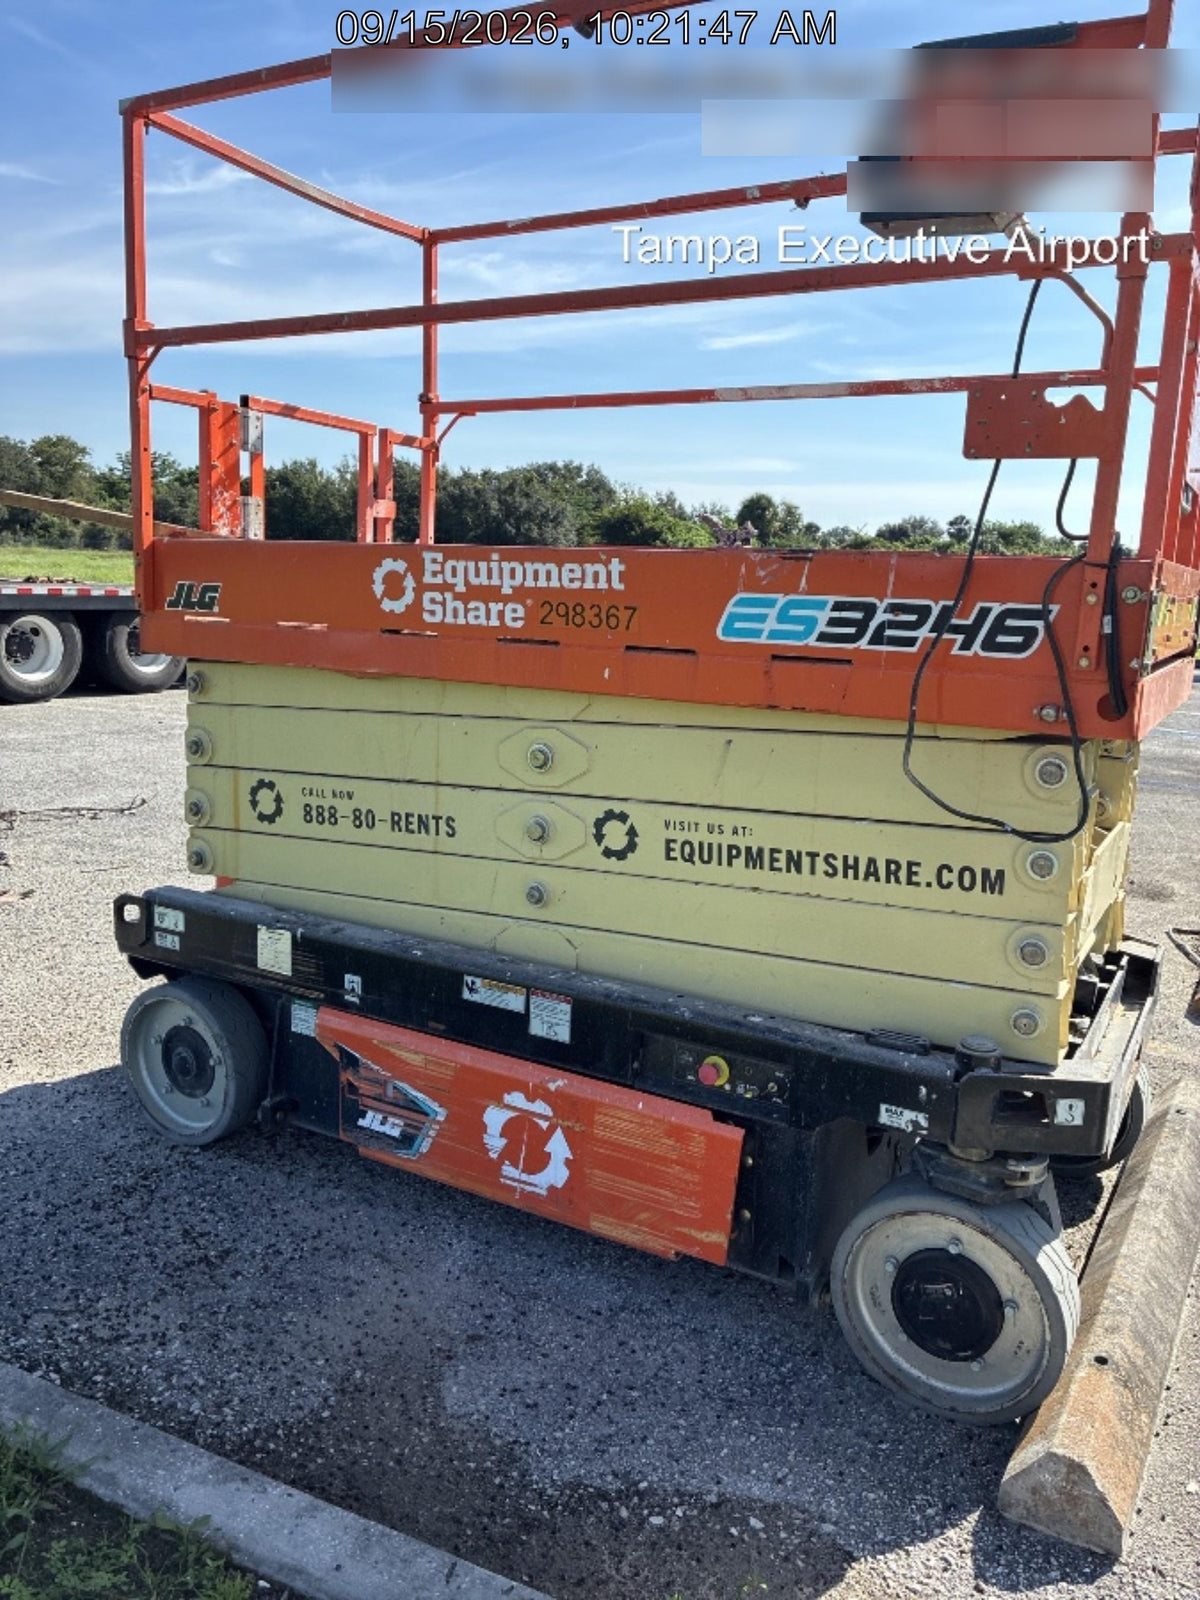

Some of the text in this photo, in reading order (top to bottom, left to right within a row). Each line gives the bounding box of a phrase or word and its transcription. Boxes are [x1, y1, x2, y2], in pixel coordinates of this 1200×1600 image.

[422, 551, 626, 594] Equipment
[164, 580, 222, 612] JLG
[422, 591, 638, 631] Share 298367
[717, 593, 1059, 658] ES3246
[301, 787, 355, 800] CALL NOW
[303, 803, 456, 838] 888-80-RENTS
[664, 819, 753, 837] VISIT US AT:
[664, 837, 1006, 896] EQUIPMENTSHARE.COM
